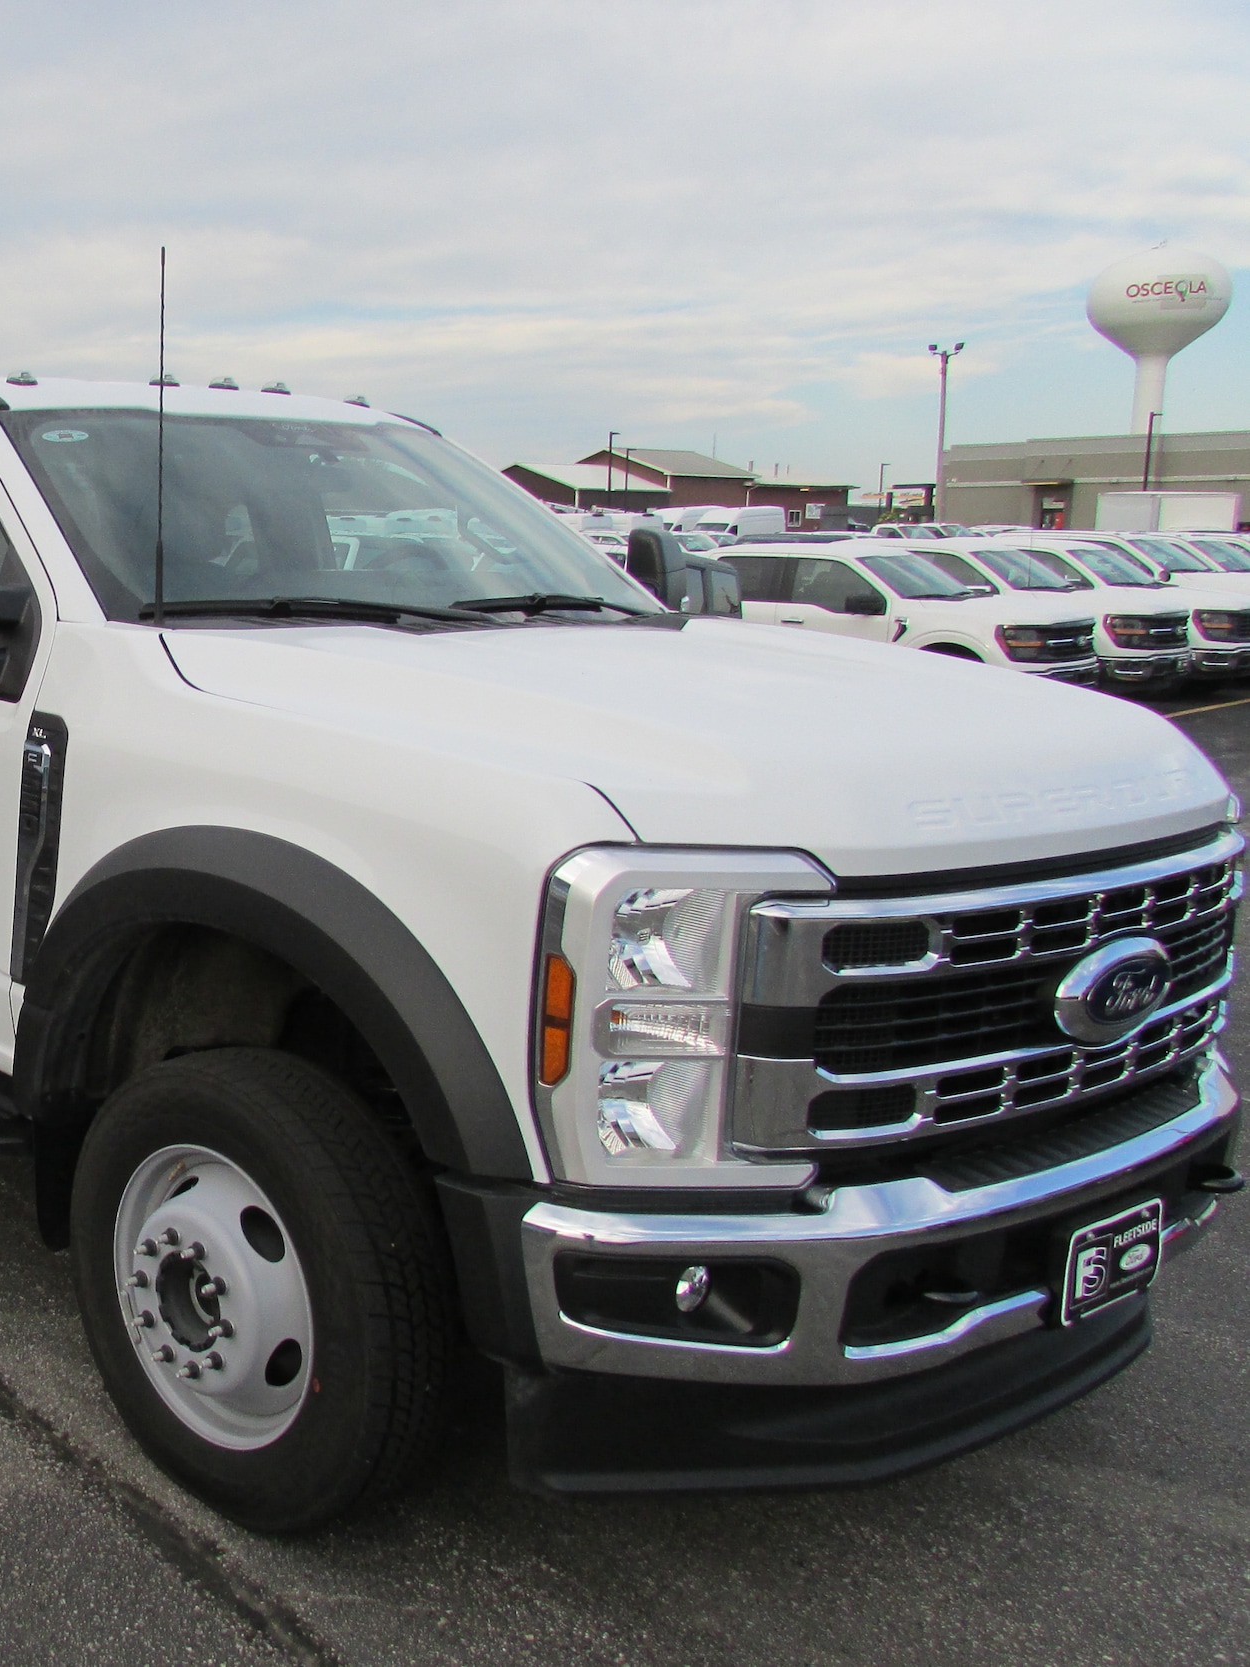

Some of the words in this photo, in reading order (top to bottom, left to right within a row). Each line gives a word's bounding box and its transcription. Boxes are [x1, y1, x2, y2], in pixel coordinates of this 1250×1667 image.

[1125, 280, 1208, 299] OSCEOLA
[907, 783, 1115, 829] SUPER
[1104, 968, 1159, 1014] Ford
[1113, 1218, 1158, 1248] FLEETSIDE
